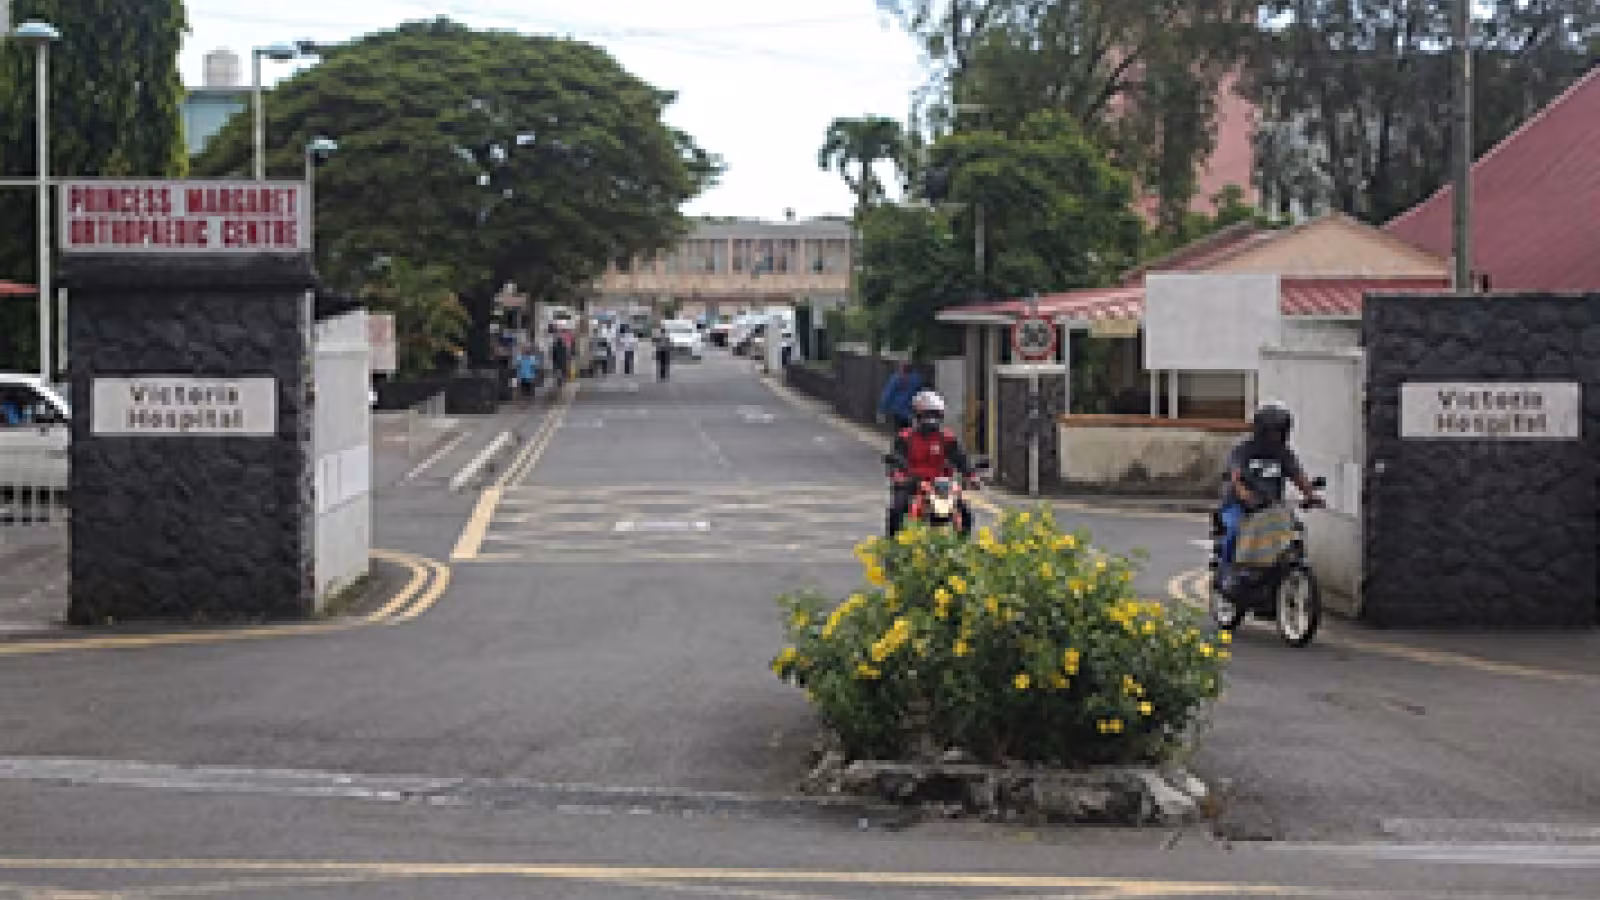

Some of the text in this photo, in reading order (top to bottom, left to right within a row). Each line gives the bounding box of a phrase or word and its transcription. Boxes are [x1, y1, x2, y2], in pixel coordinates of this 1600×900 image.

[69, 185, 297, 214] PRINCESS MARGARET
[70, 218, 298, 247] ORTHOPAEDIC CENTRE
[129, 384, 240, 406] Victoria
[1437, 389, 1543, 410] Victoria
[127, 409, 244, 433] Hospital
[1435, 413, 1547, 436] Hospital
